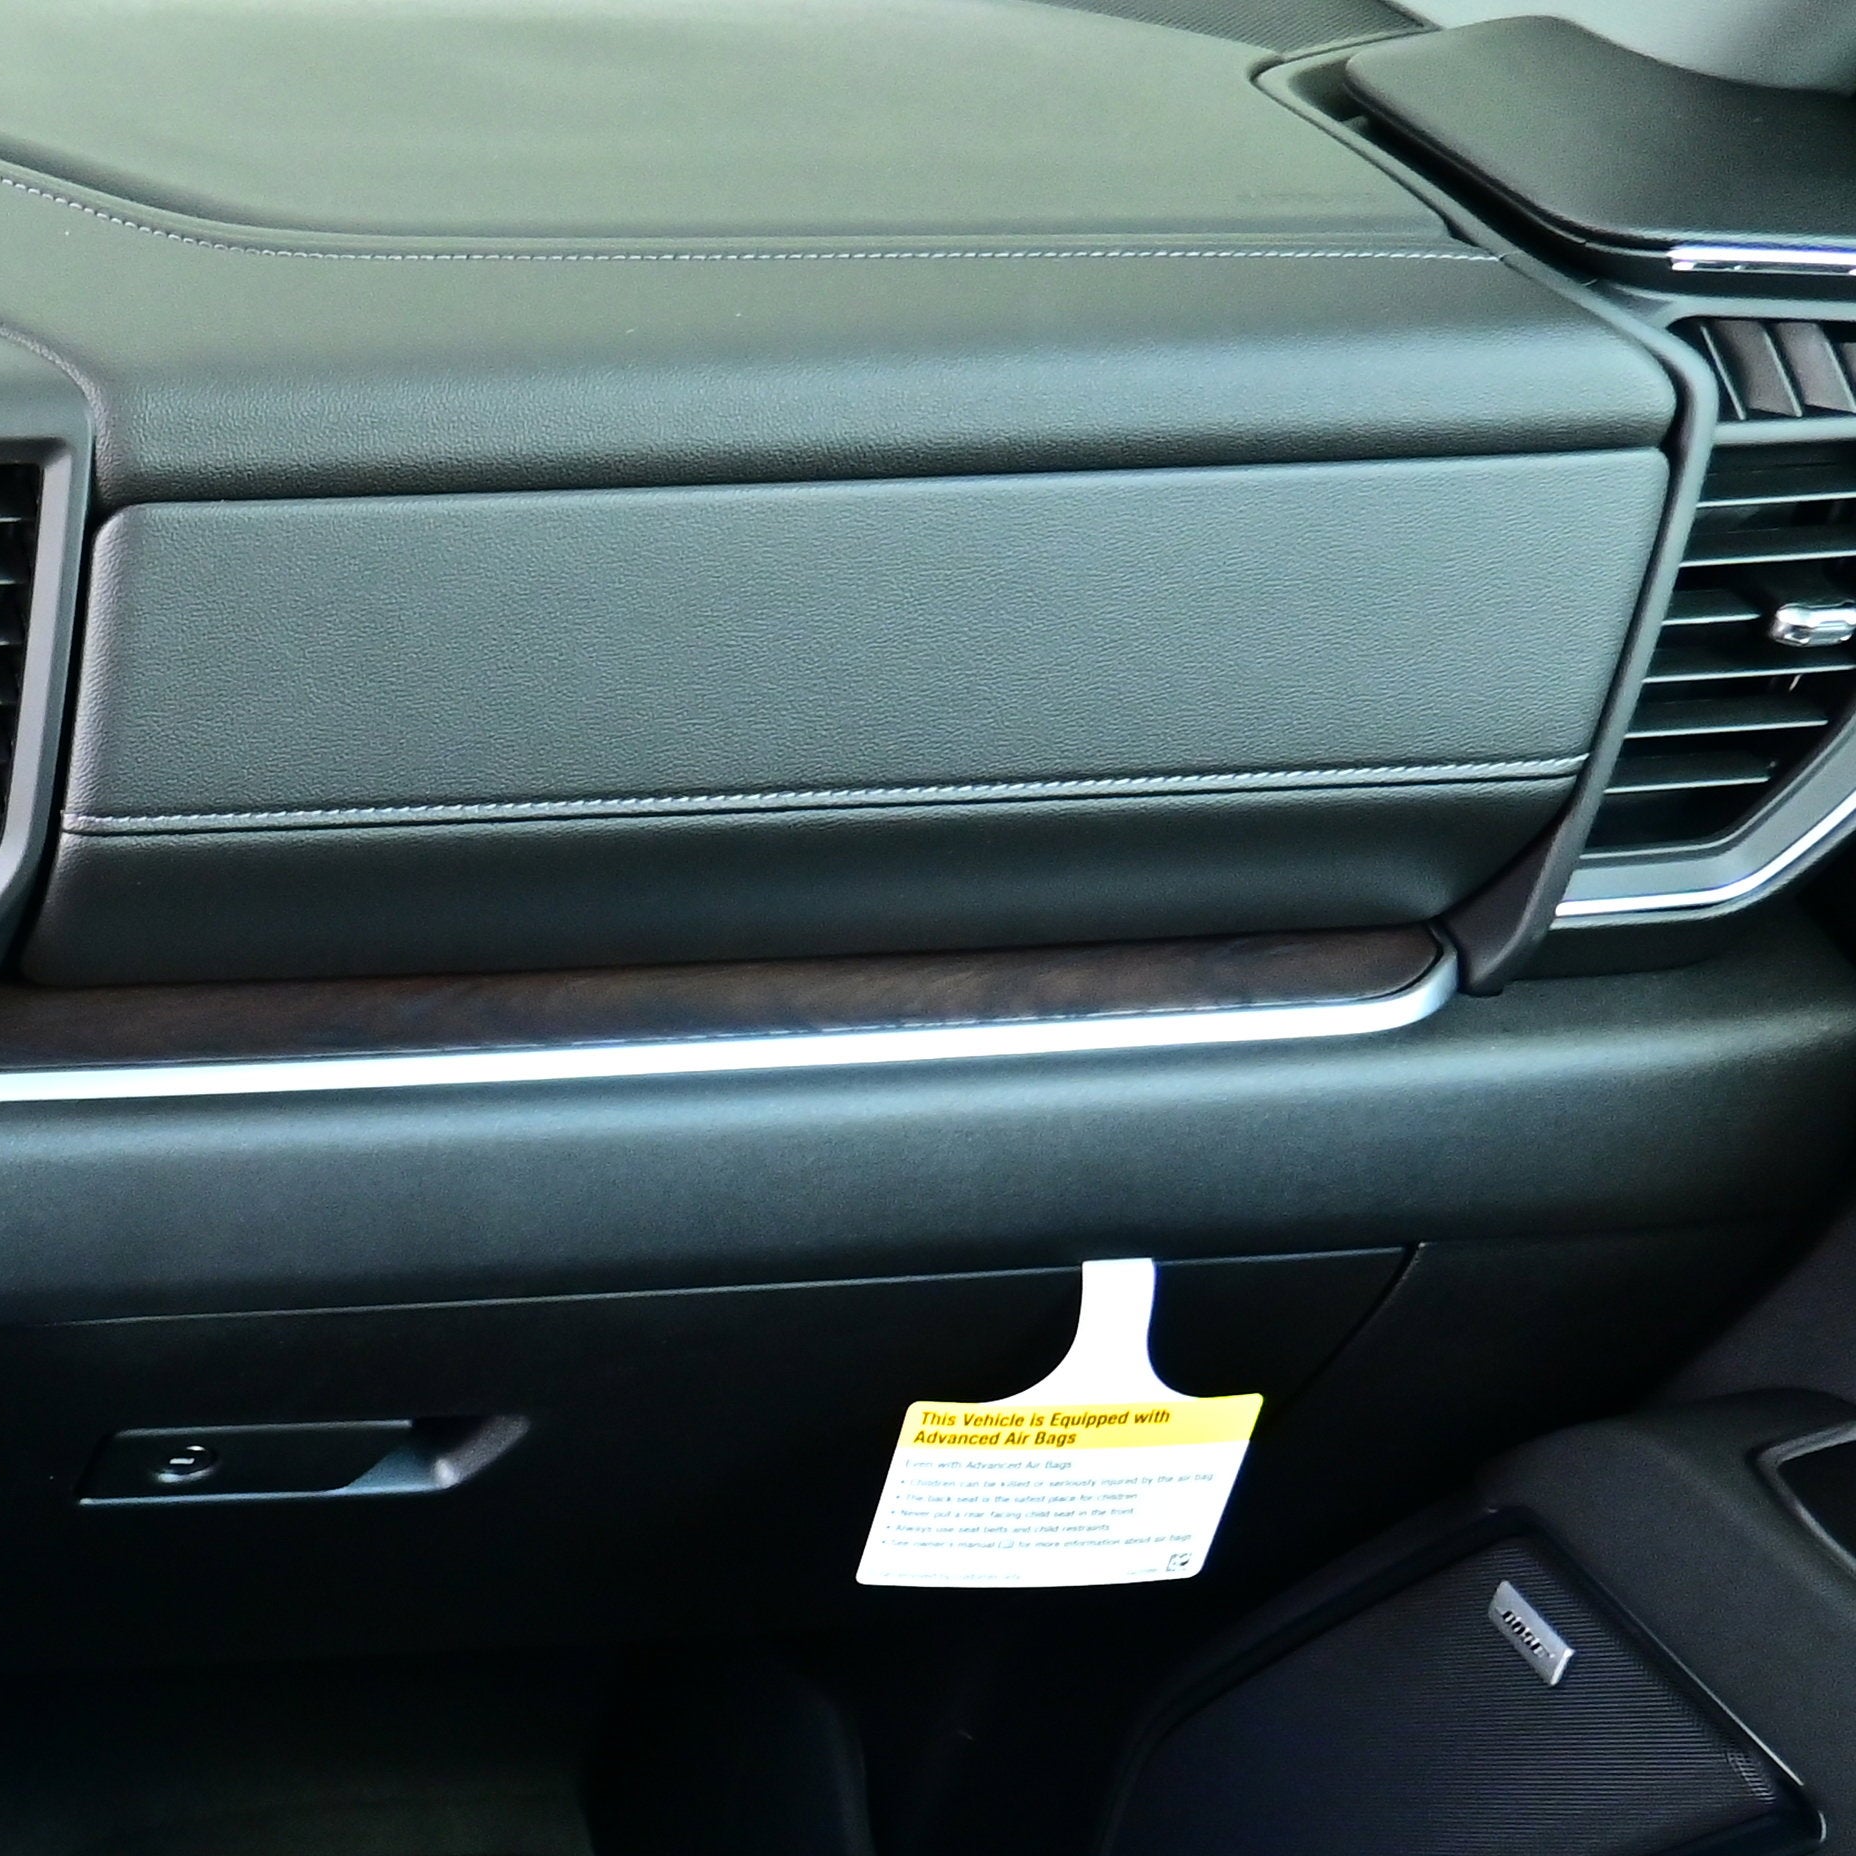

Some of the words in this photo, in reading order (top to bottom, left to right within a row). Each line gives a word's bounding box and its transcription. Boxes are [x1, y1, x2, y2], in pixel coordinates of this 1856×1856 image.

[921, 1411, 956, 1427] This
[962, 1411, 1024, 1427] Vehicle
[1029, 1411, 1044, 1427] is
[1049, 1410, 1128, 1429] Equipped
[1133, 1408, 1171, 1425] with
[913, 1430, 999, 1447] Advanced
[1004, 1431, 1030, 1446] Air
[1034, 1430, 1078, 1449] Bags
